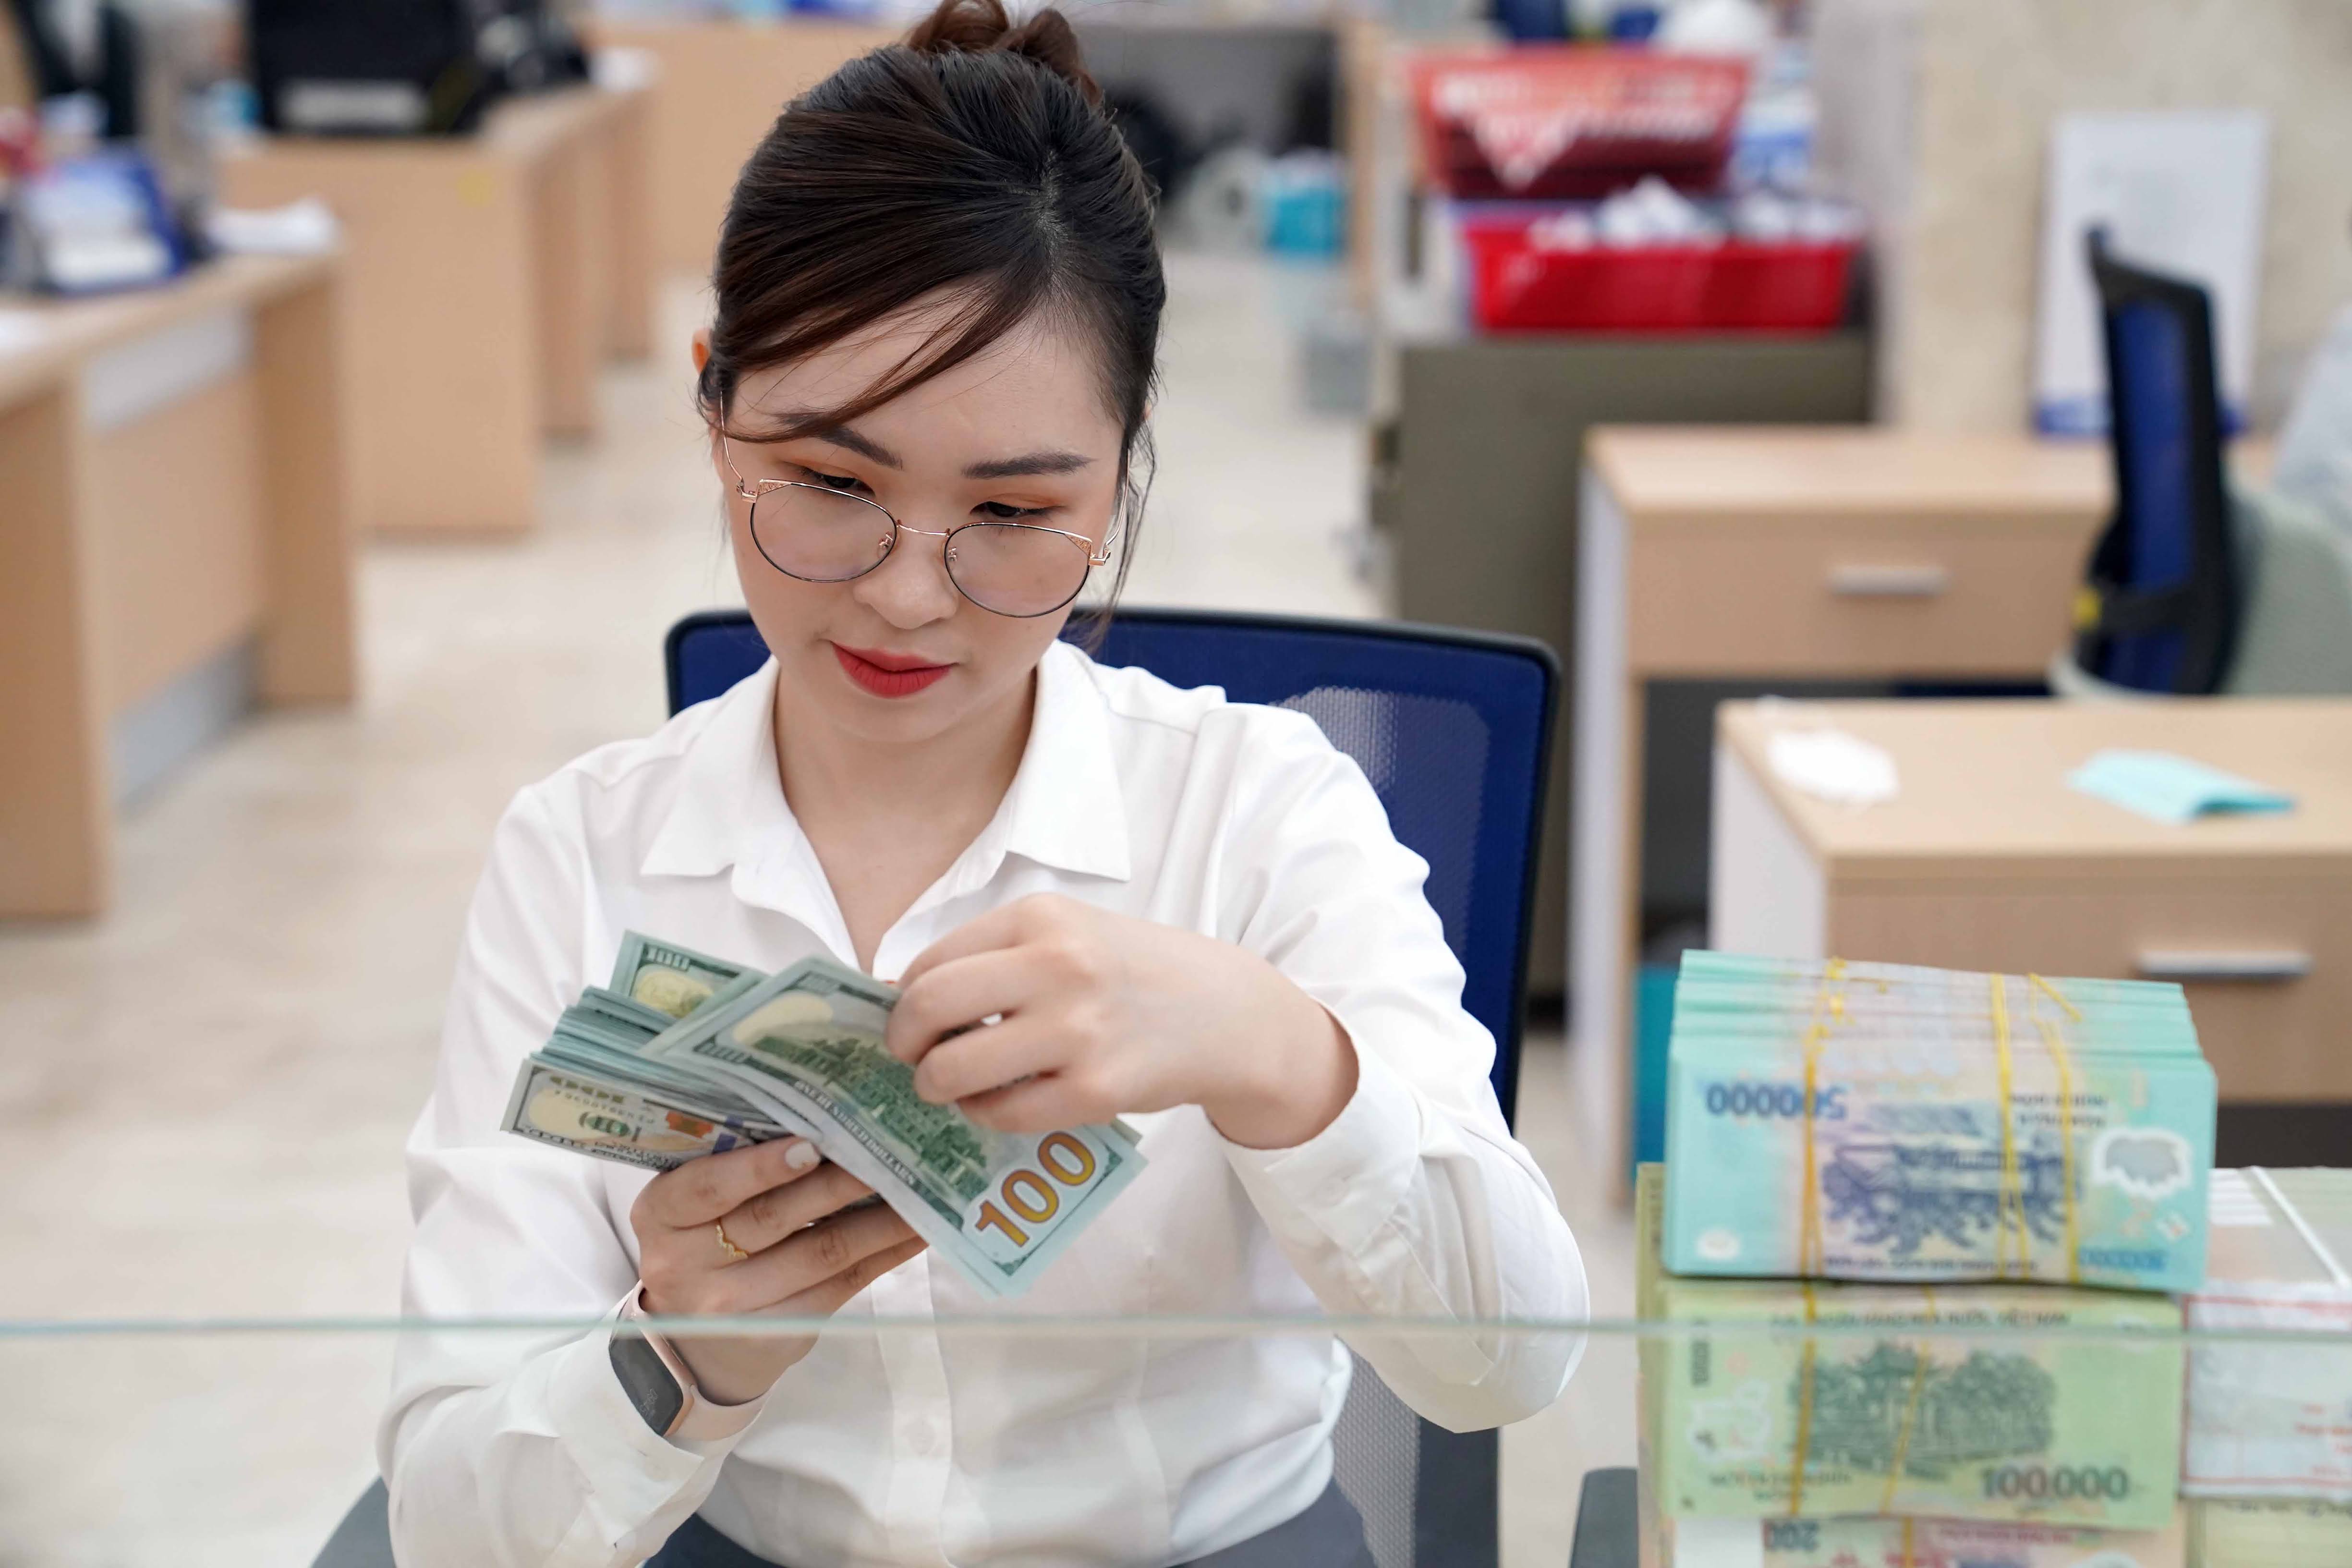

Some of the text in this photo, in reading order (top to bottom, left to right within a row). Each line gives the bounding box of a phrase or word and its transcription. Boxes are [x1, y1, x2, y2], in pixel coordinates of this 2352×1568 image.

[794, 1080, 917, 1186] ONE HUNDRED DOLLARS
[976, 1131, 1096, 1247] 100
